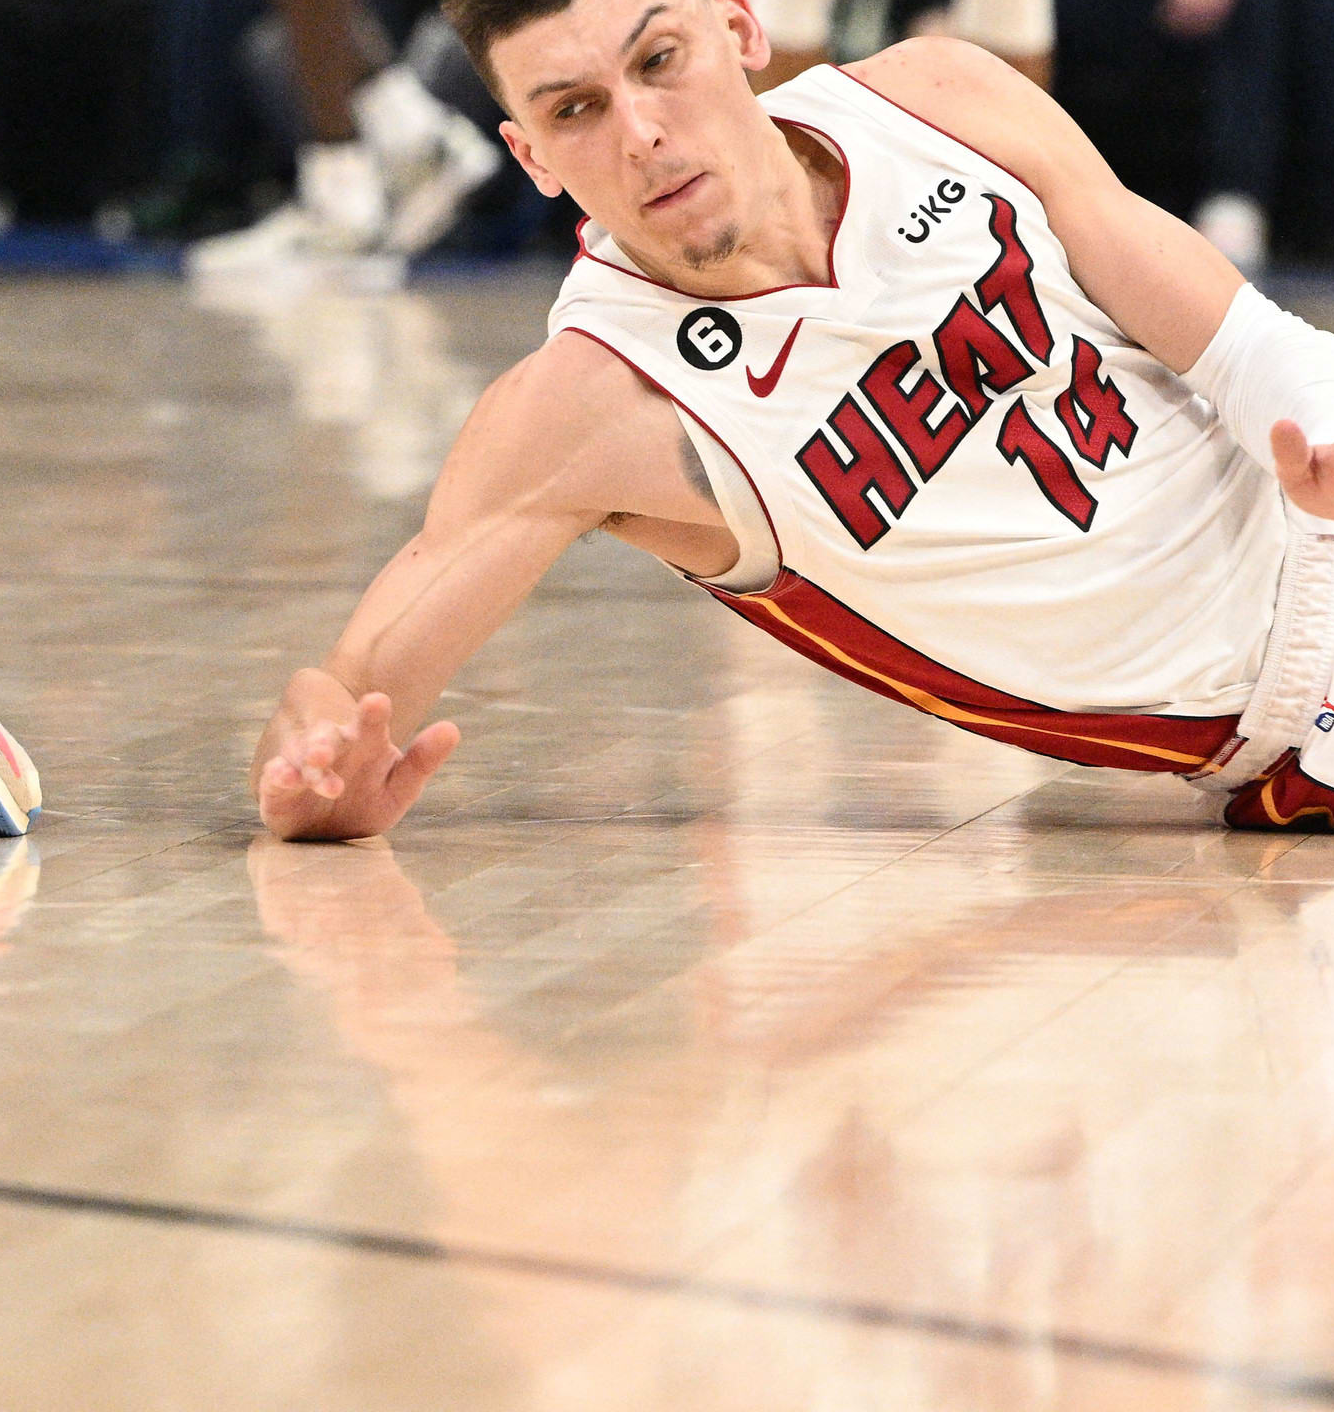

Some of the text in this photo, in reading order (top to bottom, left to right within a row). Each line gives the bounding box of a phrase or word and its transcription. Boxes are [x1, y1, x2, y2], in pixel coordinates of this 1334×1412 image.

[687, 316, 734, 364] 6
[794, 193, 1055, 551] HEAT
[995, 333, 1139, 533] 14
